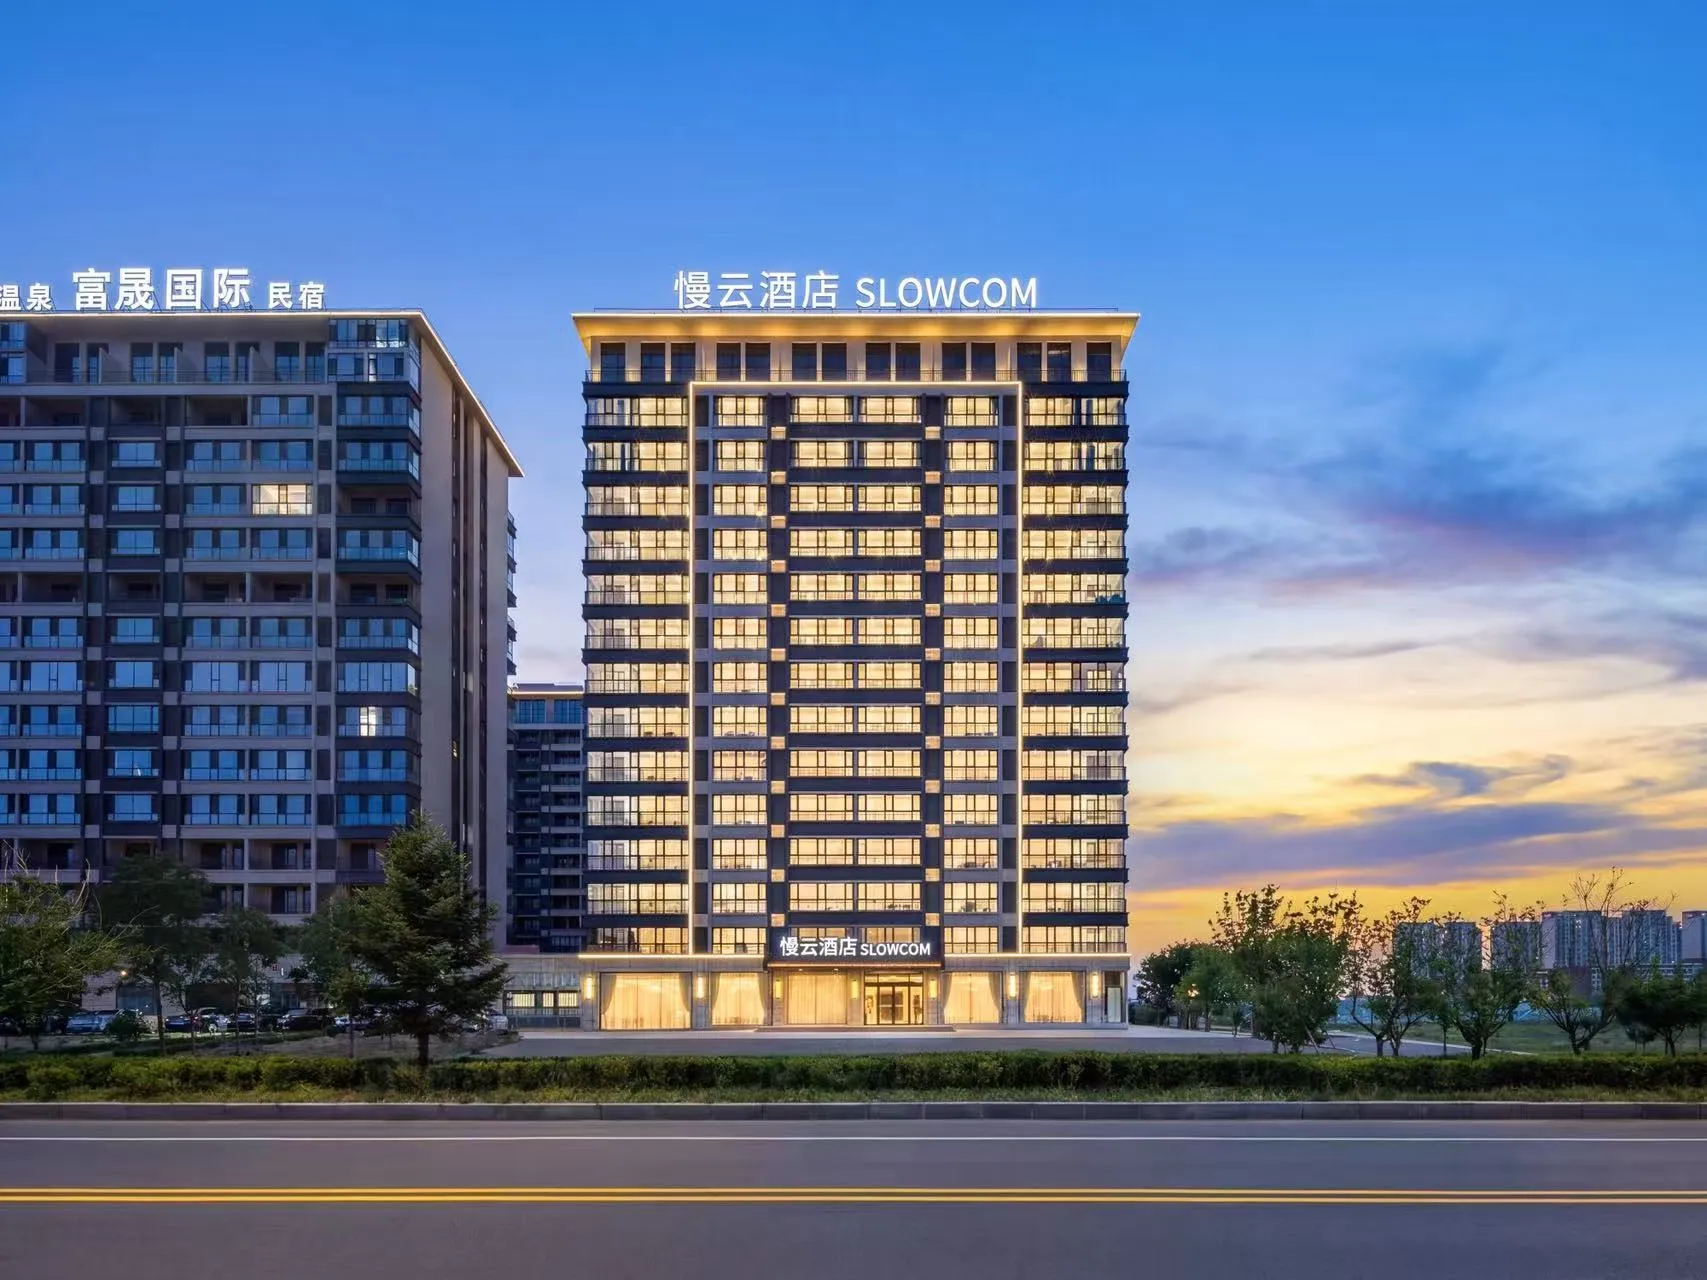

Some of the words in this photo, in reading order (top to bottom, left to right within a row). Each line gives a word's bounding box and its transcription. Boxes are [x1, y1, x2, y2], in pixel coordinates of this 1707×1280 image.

[0, 283, 52, 311] 温泉
[73, 267, 251, 310] 富晟国际
[268, 281, 325, 309] 民宿
[674, 270, 839, 309] 慢云酒店
[855, 277, 1037, 308] SLOWCOM
[779, 936, 858, 957] 慢云酒店
[860, 943, 931, 956] SLOWCOM
